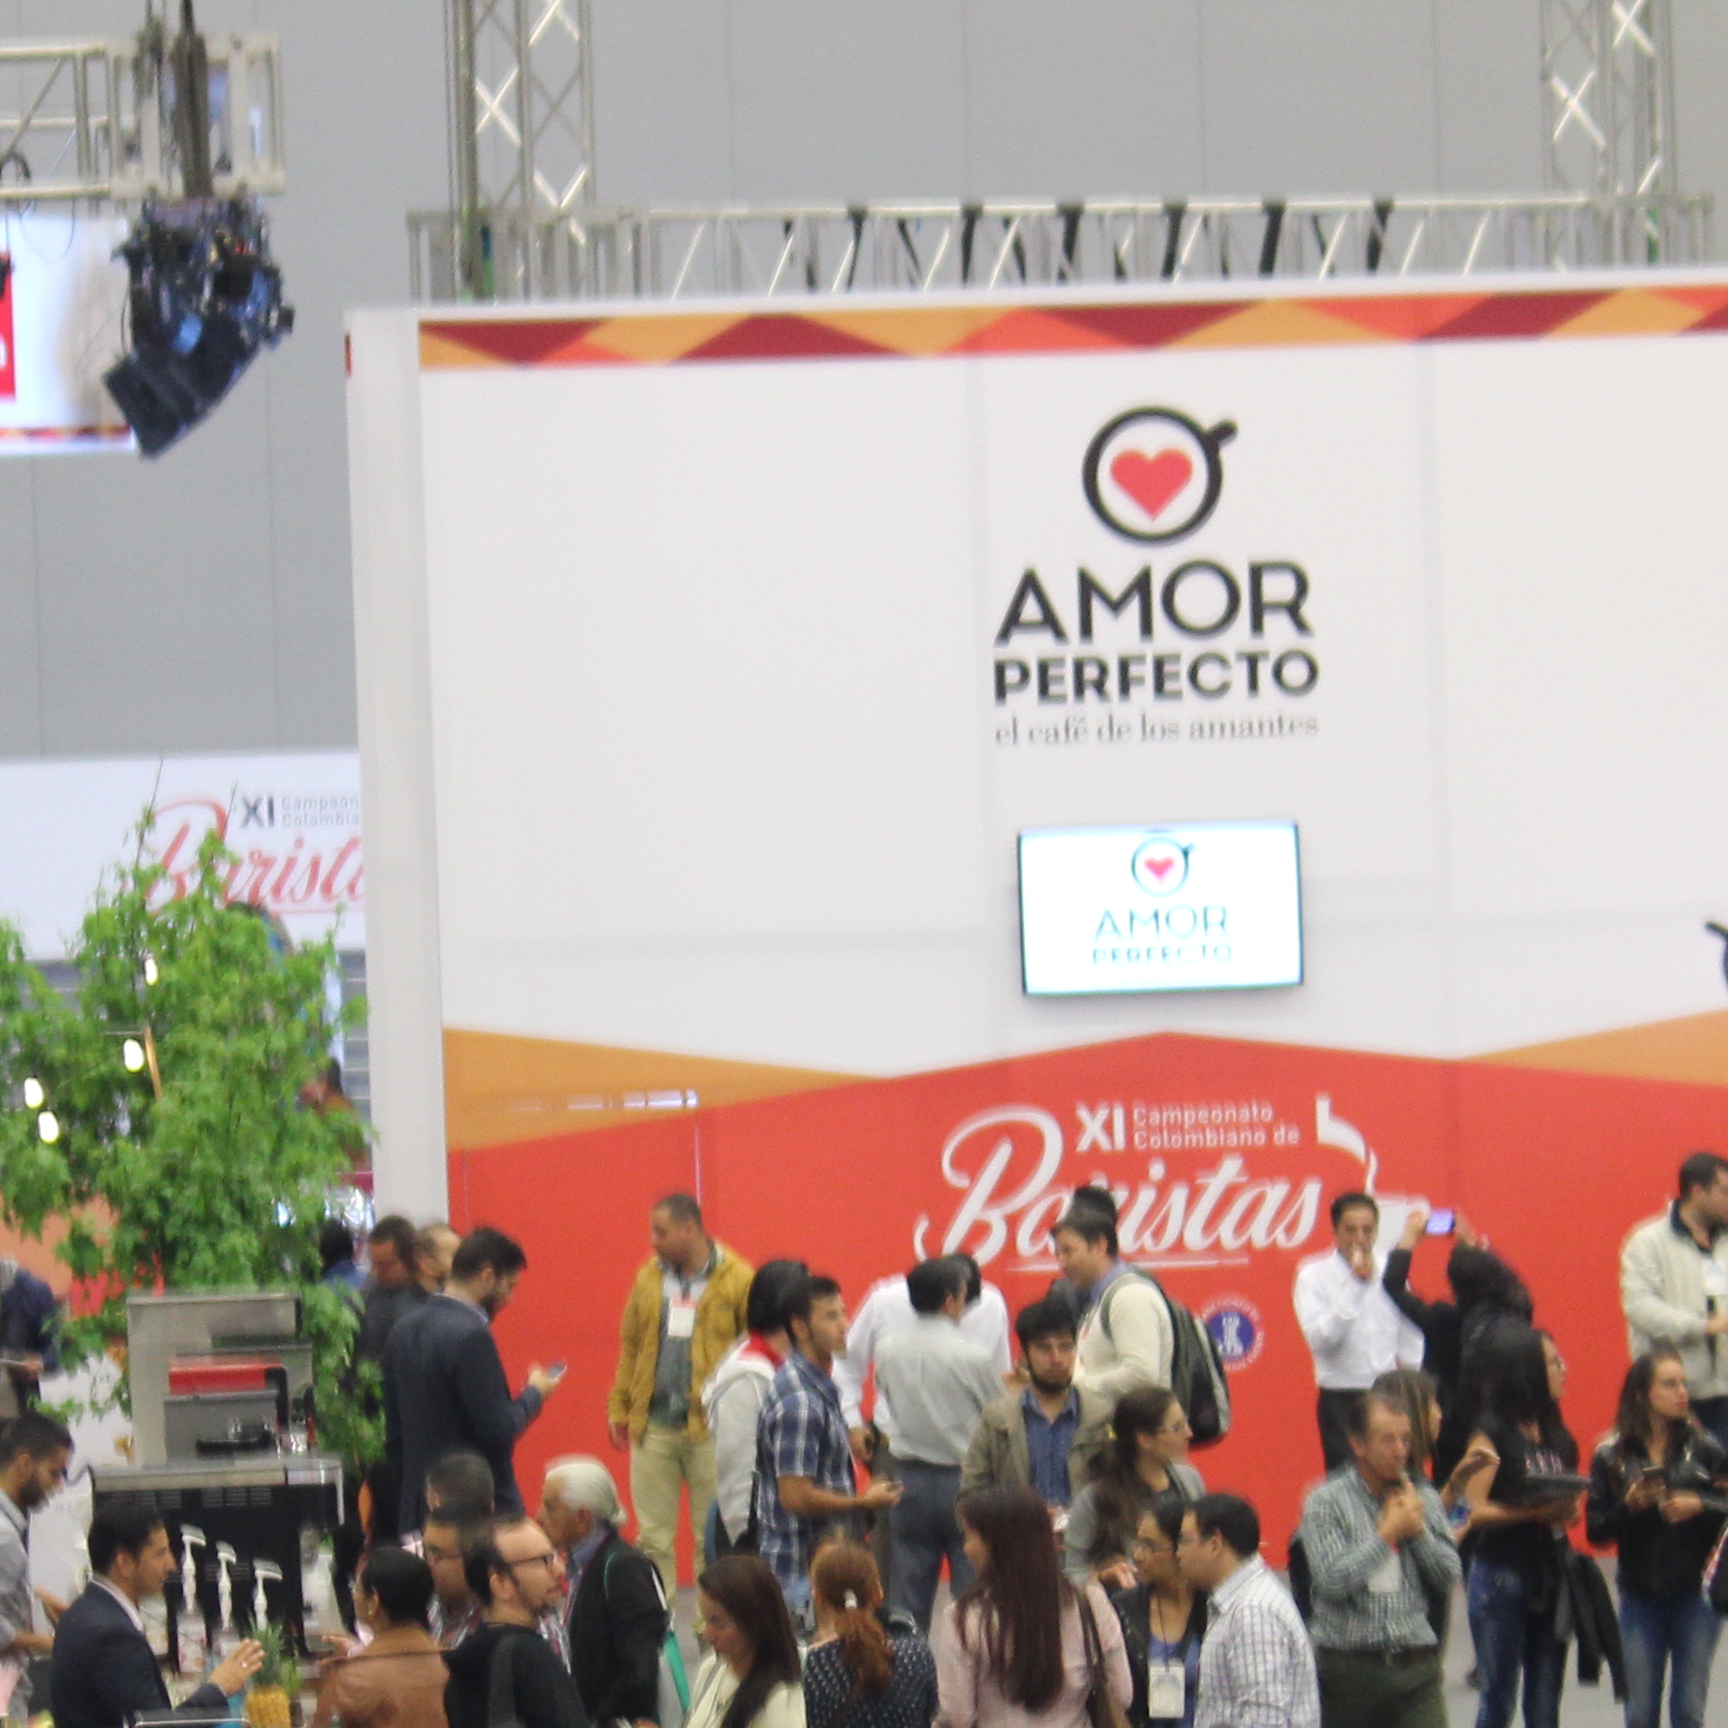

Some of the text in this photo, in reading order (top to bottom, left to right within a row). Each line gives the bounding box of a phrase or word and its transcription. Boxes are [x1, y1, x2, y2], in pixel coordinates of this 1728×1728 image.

[993, 558, 1314, 647] AMOR
[993, 649, 1320, 706] PERFECTO
[995, 711, 1319, 746] el café de los amantes
[241, 796, 274, 828] XI
[1092, 903, 1229, 944] AMOR
[1092, 942, 1233, 969] PERFECTO
[1075, 1099, 1274, 1152] XI Campeonato
[1133, 1122, 1301, 1150] Colombiano de
[915, 1104, 1323, 1268] Baistas
